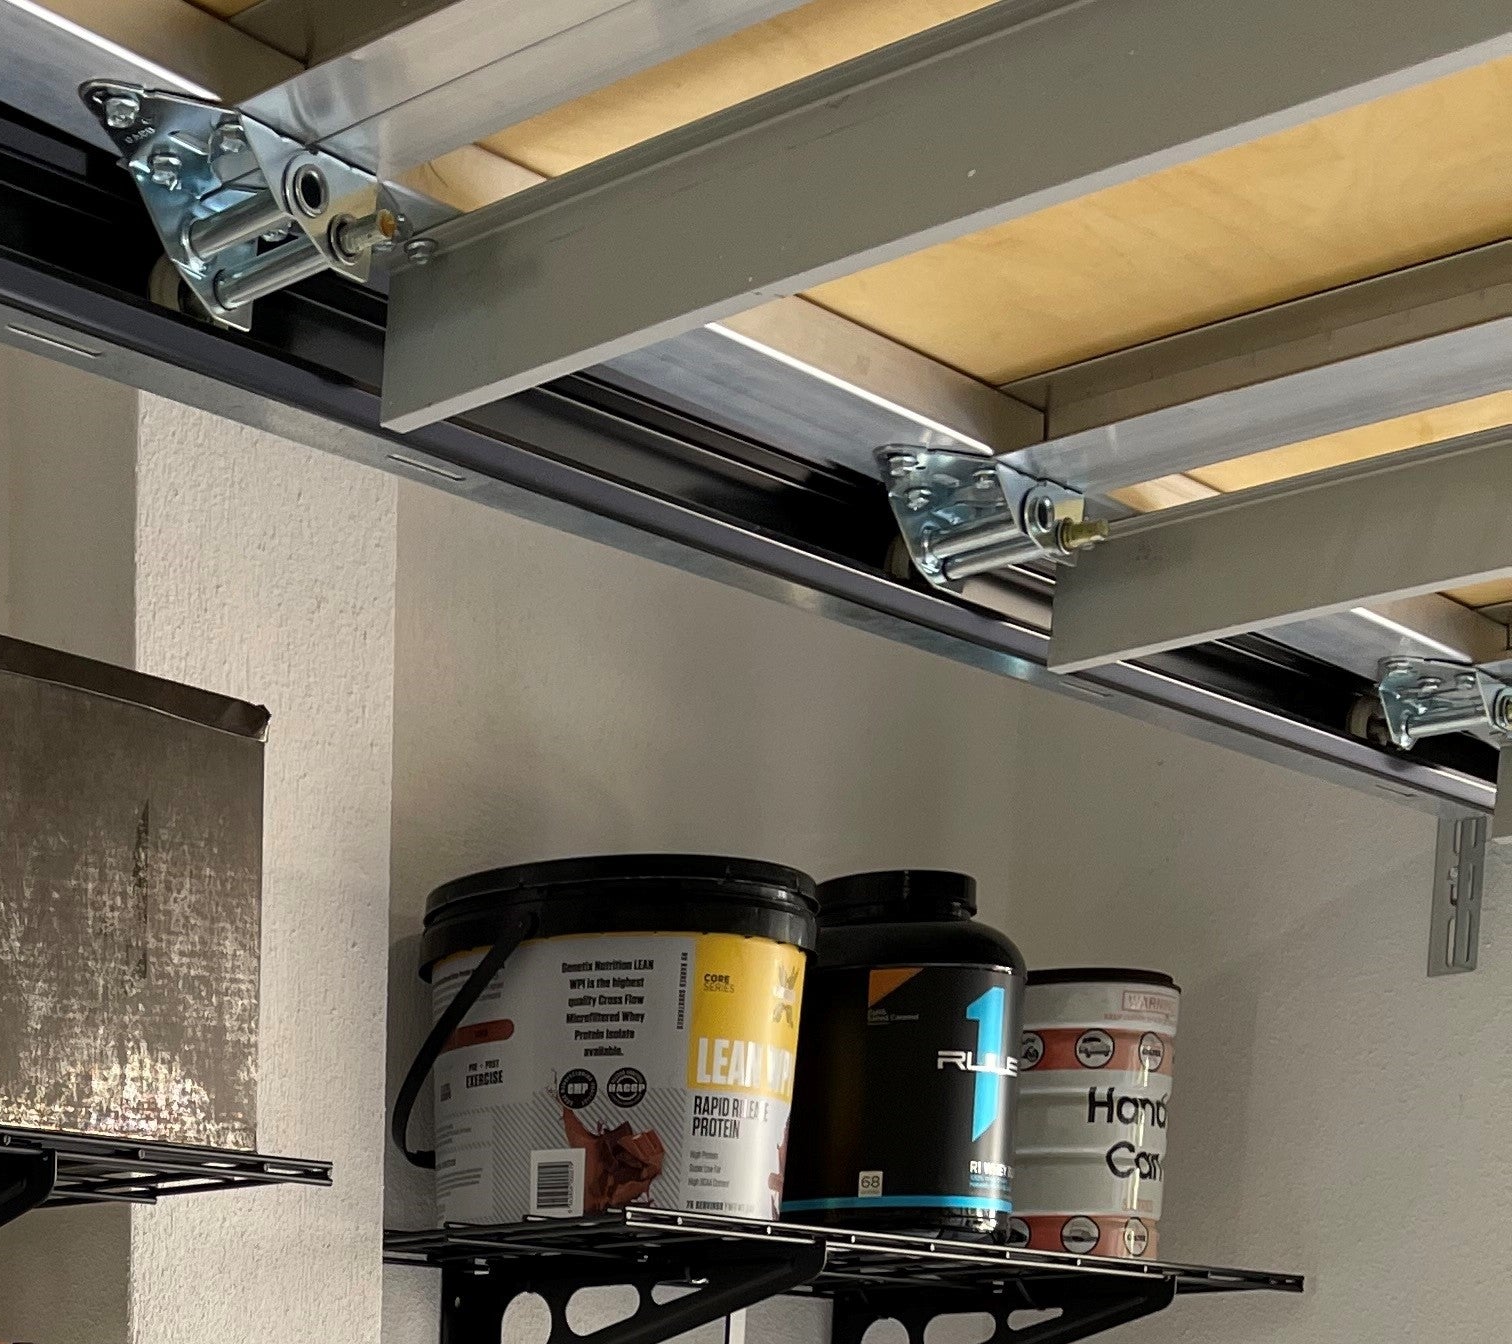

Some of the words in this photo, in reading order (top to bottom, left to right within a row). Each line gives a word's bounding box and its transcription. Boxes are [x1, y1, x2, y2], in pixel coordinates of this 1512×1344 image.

[594, 959, 633, 971] Nutrition
[634, 959, 655, 970] LEAN
[569, 979, 586, 990] WPI
[587, 978, 595, 989] is
[596, 978, 611, 989] the
[612, 977, 645, 989] highest
[703, 973, 730, 985] CORE
[703, 982, 735, 994] SERIES
[568, 995, 597, 1008] quality
[598, 995, 623, 1006] Cross
[624, 994, 645, 1005] Flow
[622, 1011, 645, 1023] Whey
[574, 1029, 604, 1041] Protein
[605, 1028, 635, 1040] Isolate
[696, 1037, 763, 1089] LEAN
[937, 1050, 1018, 1078] RULE
[966, 986, 1006, 1143] 1
[466, 1070, 504, 1089] EXERCISE
[567, 1082, 589, 1095] GMP
[608, 1083, 646, 1093] HACCP
[693, 1095, 729, 1117] RAPID
[692, 1117, 741, 1139] PROTEIN
[860, 1175, 881, 1188] 68
